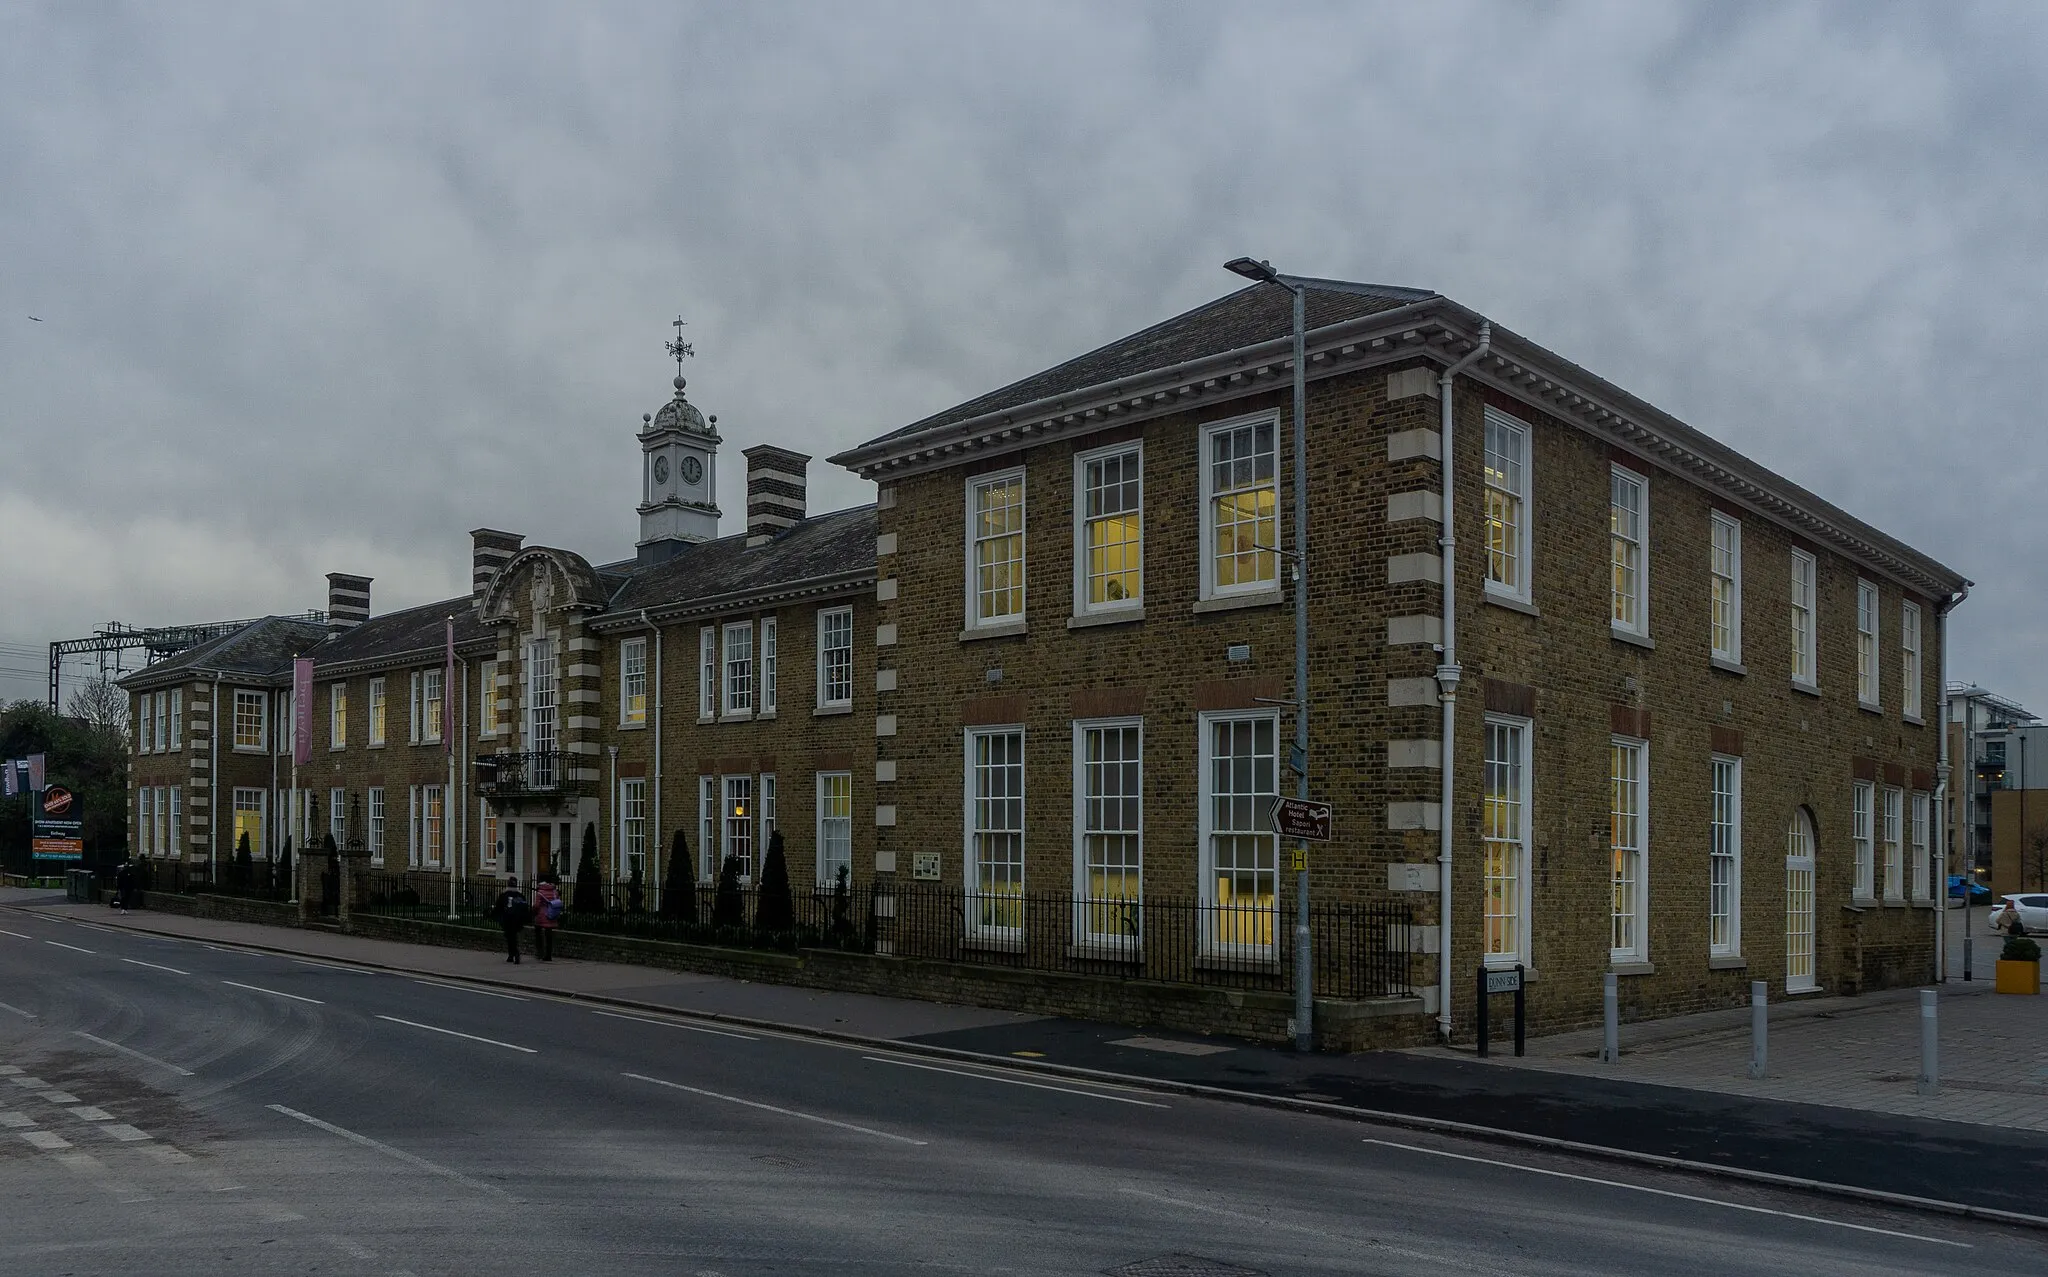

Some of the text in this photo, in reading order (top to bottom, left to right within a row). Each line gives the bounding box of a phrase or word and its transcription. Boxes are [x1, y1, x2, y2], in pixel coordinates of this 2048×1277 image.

[1286, 802, 1308, 811] Atlantic
[1288, 810, 1305, 819] Hotel
[1291, 819, 1311, 828] Sapori
[1285, 827, 1316, 837] restaurant
[1294, 852, 1304, 868] H
[1507, 976, 1517, 985] SIDE
